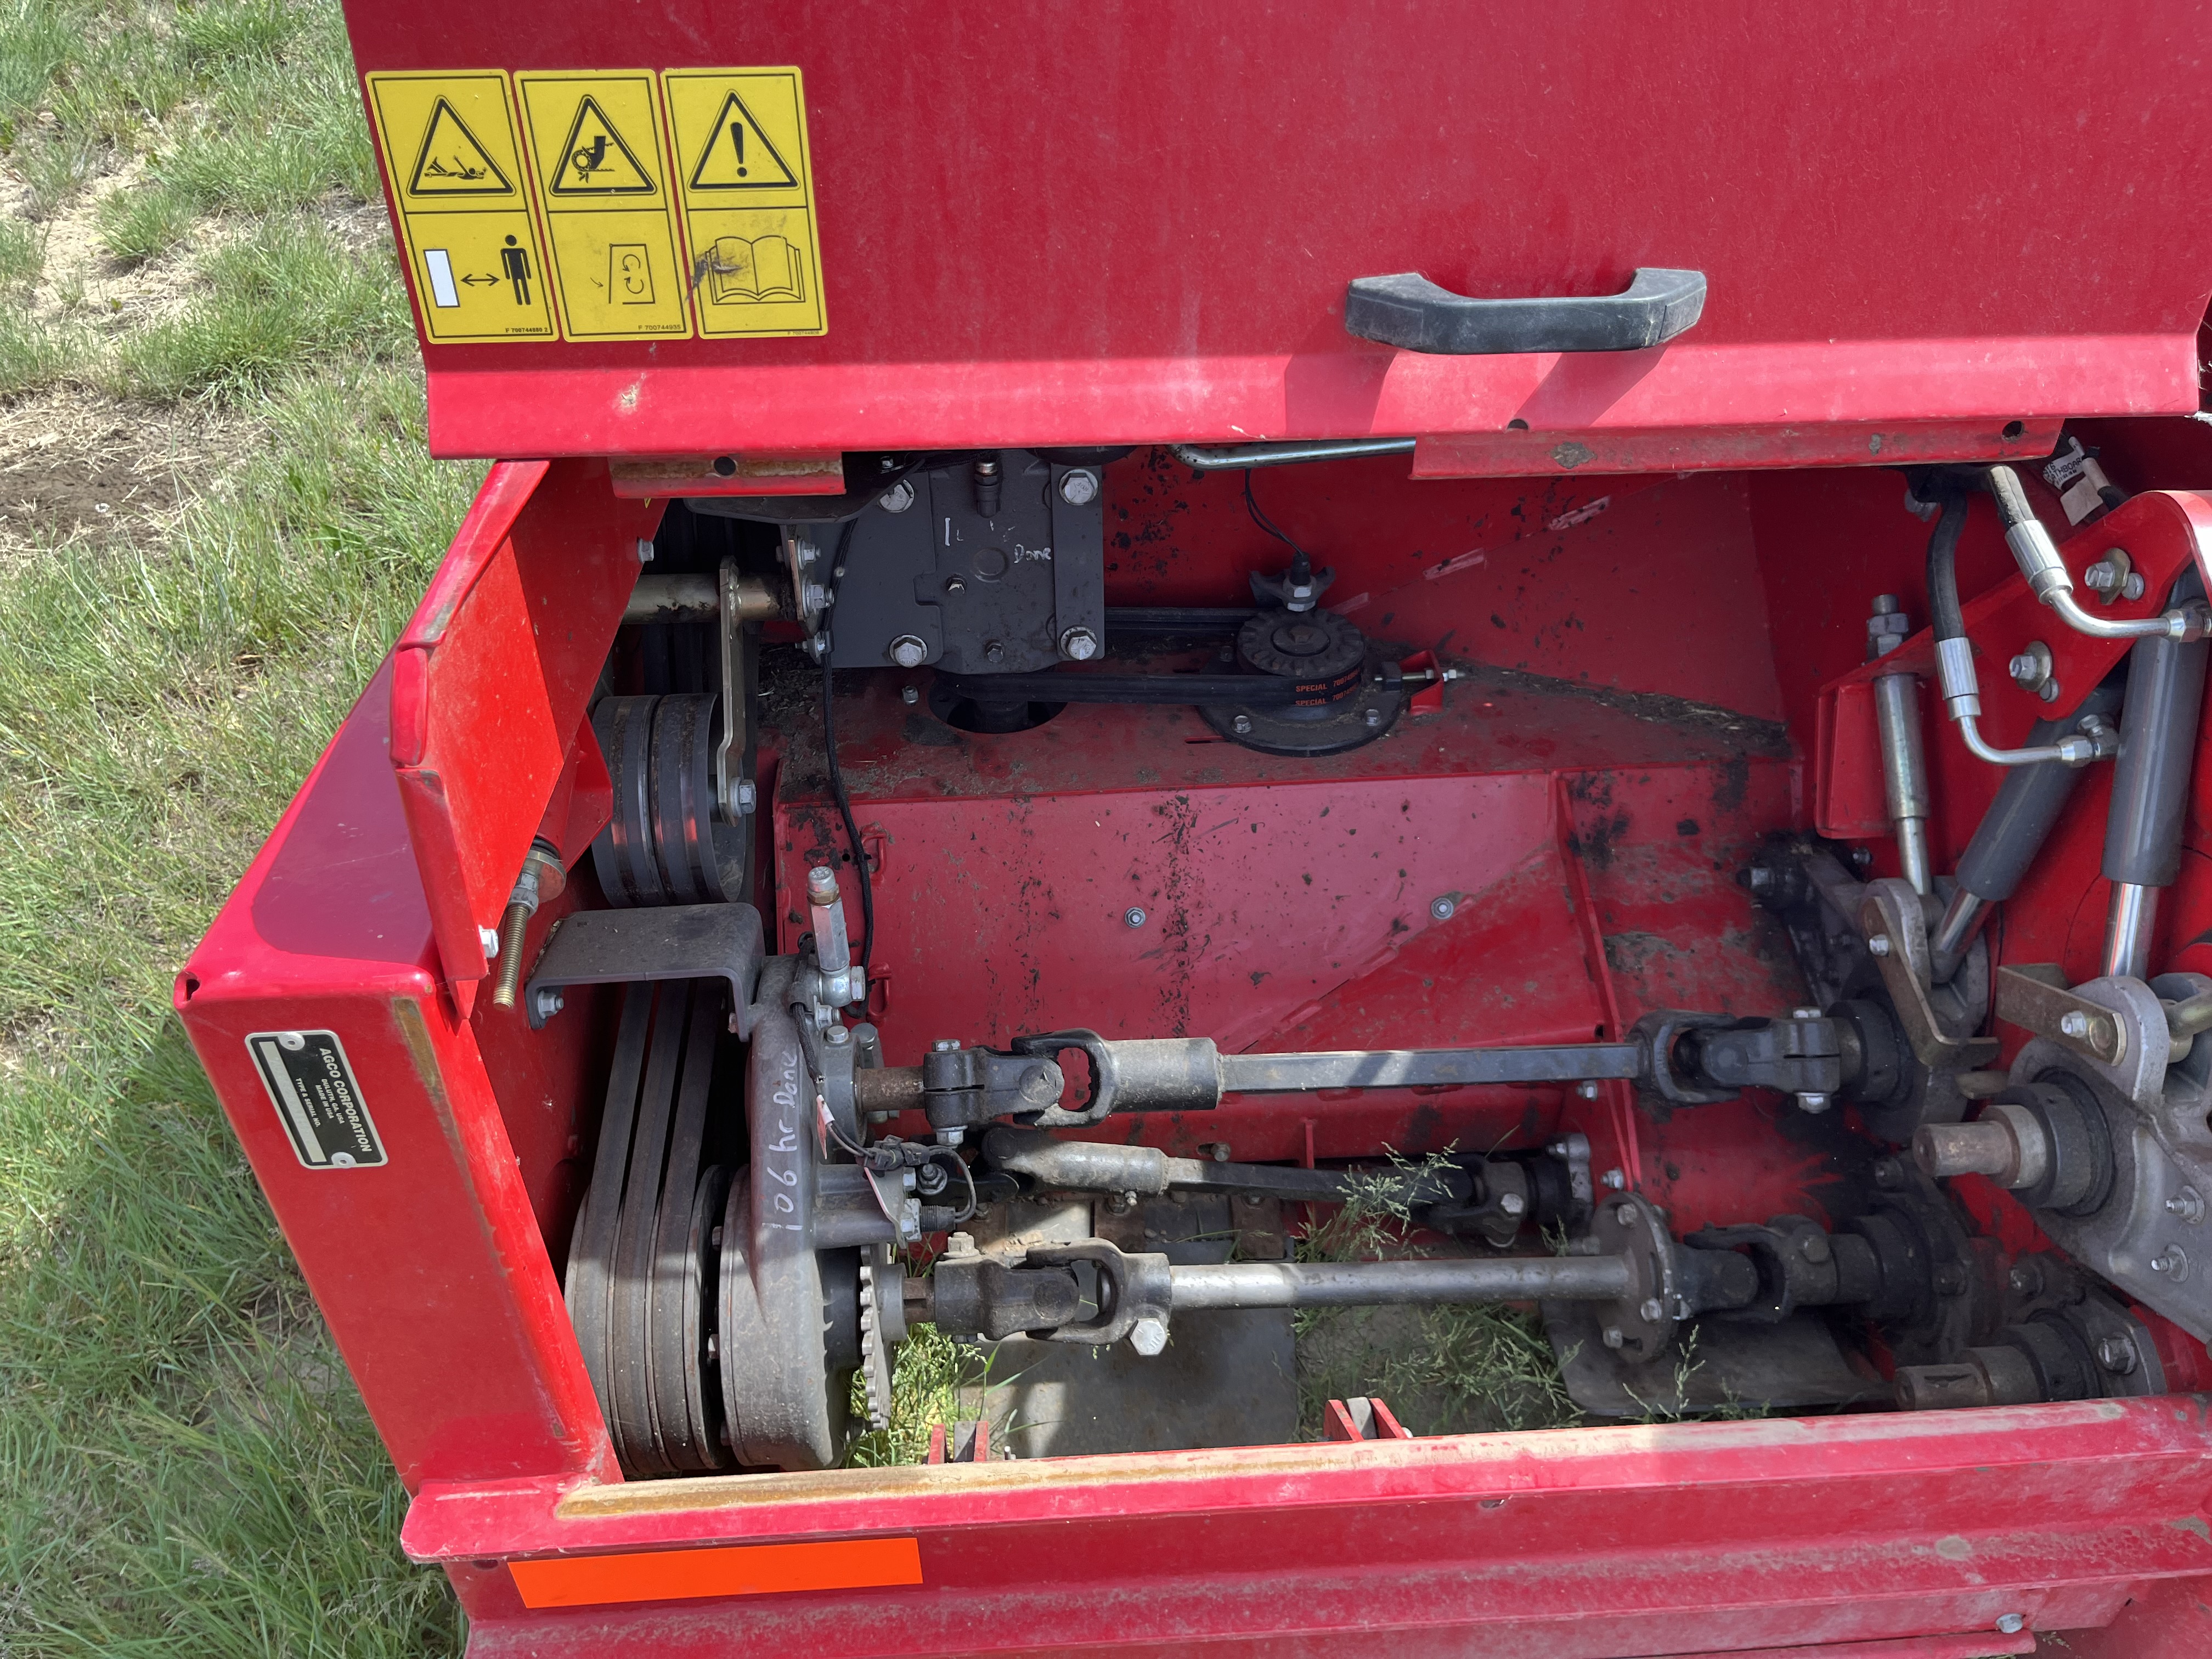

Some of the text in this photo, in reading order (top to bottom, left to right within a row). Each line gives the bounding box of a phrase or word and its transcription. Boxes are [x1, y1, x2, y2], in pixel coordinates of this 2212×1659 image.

[1295, 683, 1328, 692] SPECIAL
[1295, 698, 1327, 707] SPECIAL
[295, 1077, 307, 1094] TYPE
[304, 1098, 317, 1118] SERIAL
[313, 1118, 321, 1127] NO.
[315, 1085, 327, 1101] MADE
[325, 1107, 334, 1119] USA
[319, 1048, 373, 1152] AGCO CORPORATION
[336, 1113, 345, 1124] USA
[769, 1119, 798, 1152] hr
